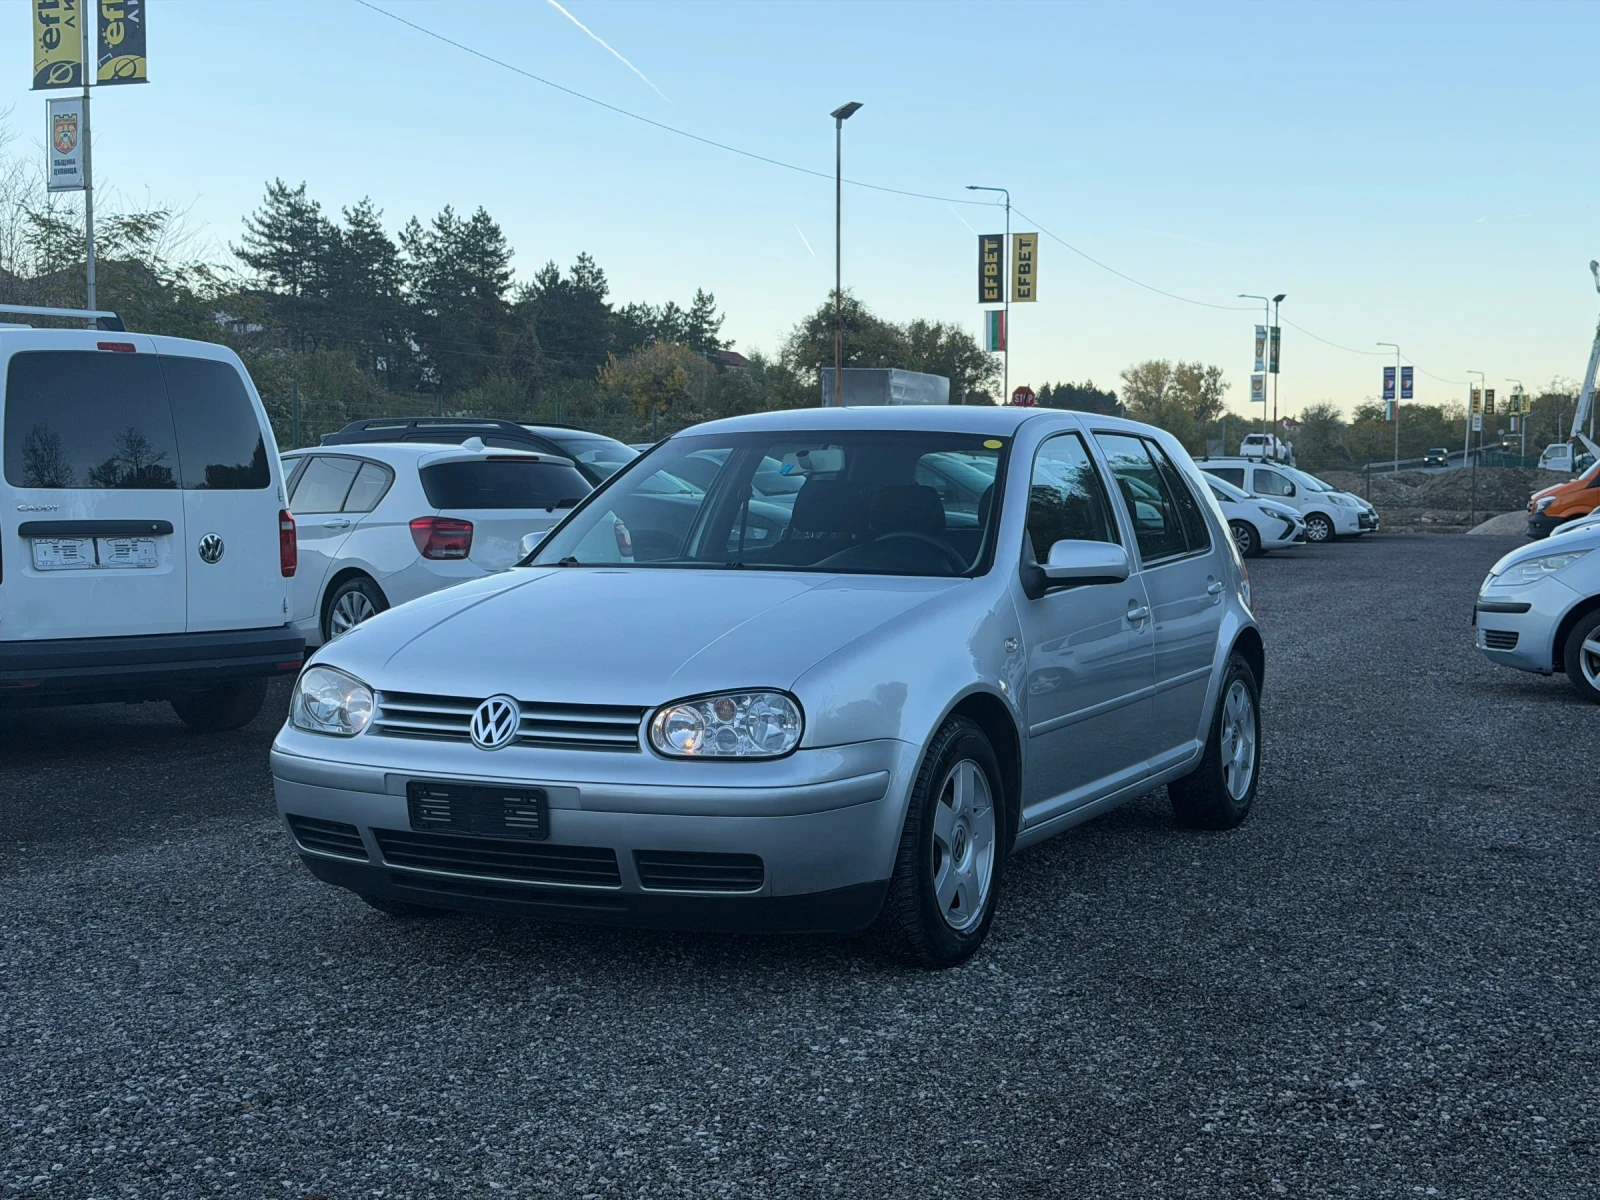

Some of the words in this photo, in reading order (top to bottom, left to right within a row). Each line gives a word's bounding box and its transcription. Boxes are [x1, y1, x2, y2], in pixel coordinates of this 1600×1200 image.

[101, 0, 124, 45] ef
[984, 239, 998, 300] EFBET
[1018, 238, 1031, 298] EFBET
[17, 504, 60, 512] CADDY
[199, 534, 223, 562] VW
[473, 698, 515, 746] VW
